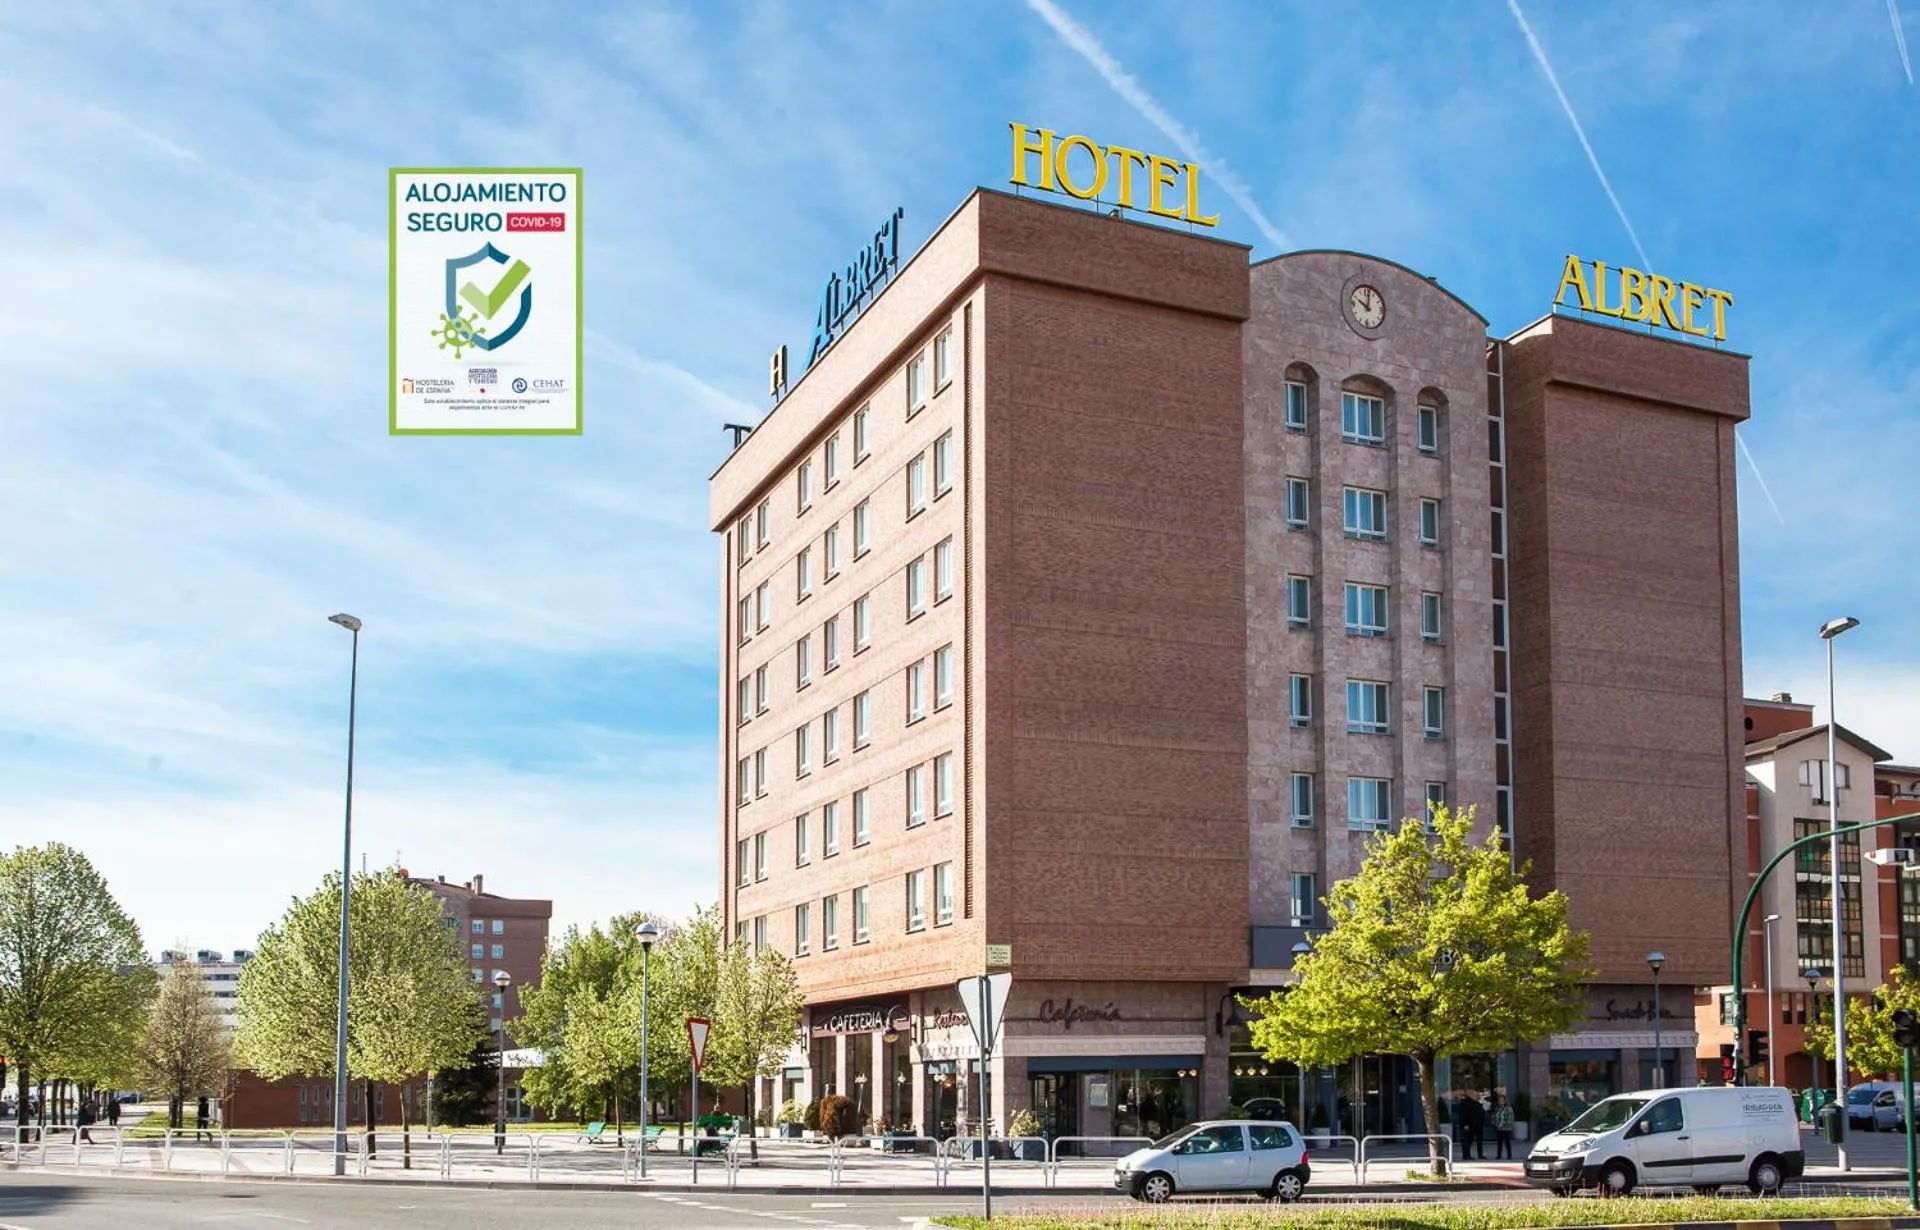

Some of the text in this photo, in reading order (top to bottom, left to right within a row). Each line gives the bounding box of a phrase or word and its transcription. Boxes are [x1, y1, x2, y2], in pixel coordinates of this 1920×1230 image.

[1009, 122, 1220, 228] HOTEL
[801, 206, 904, 372] ALBRET
[1554, 254, 1735, 341] ALBRET
